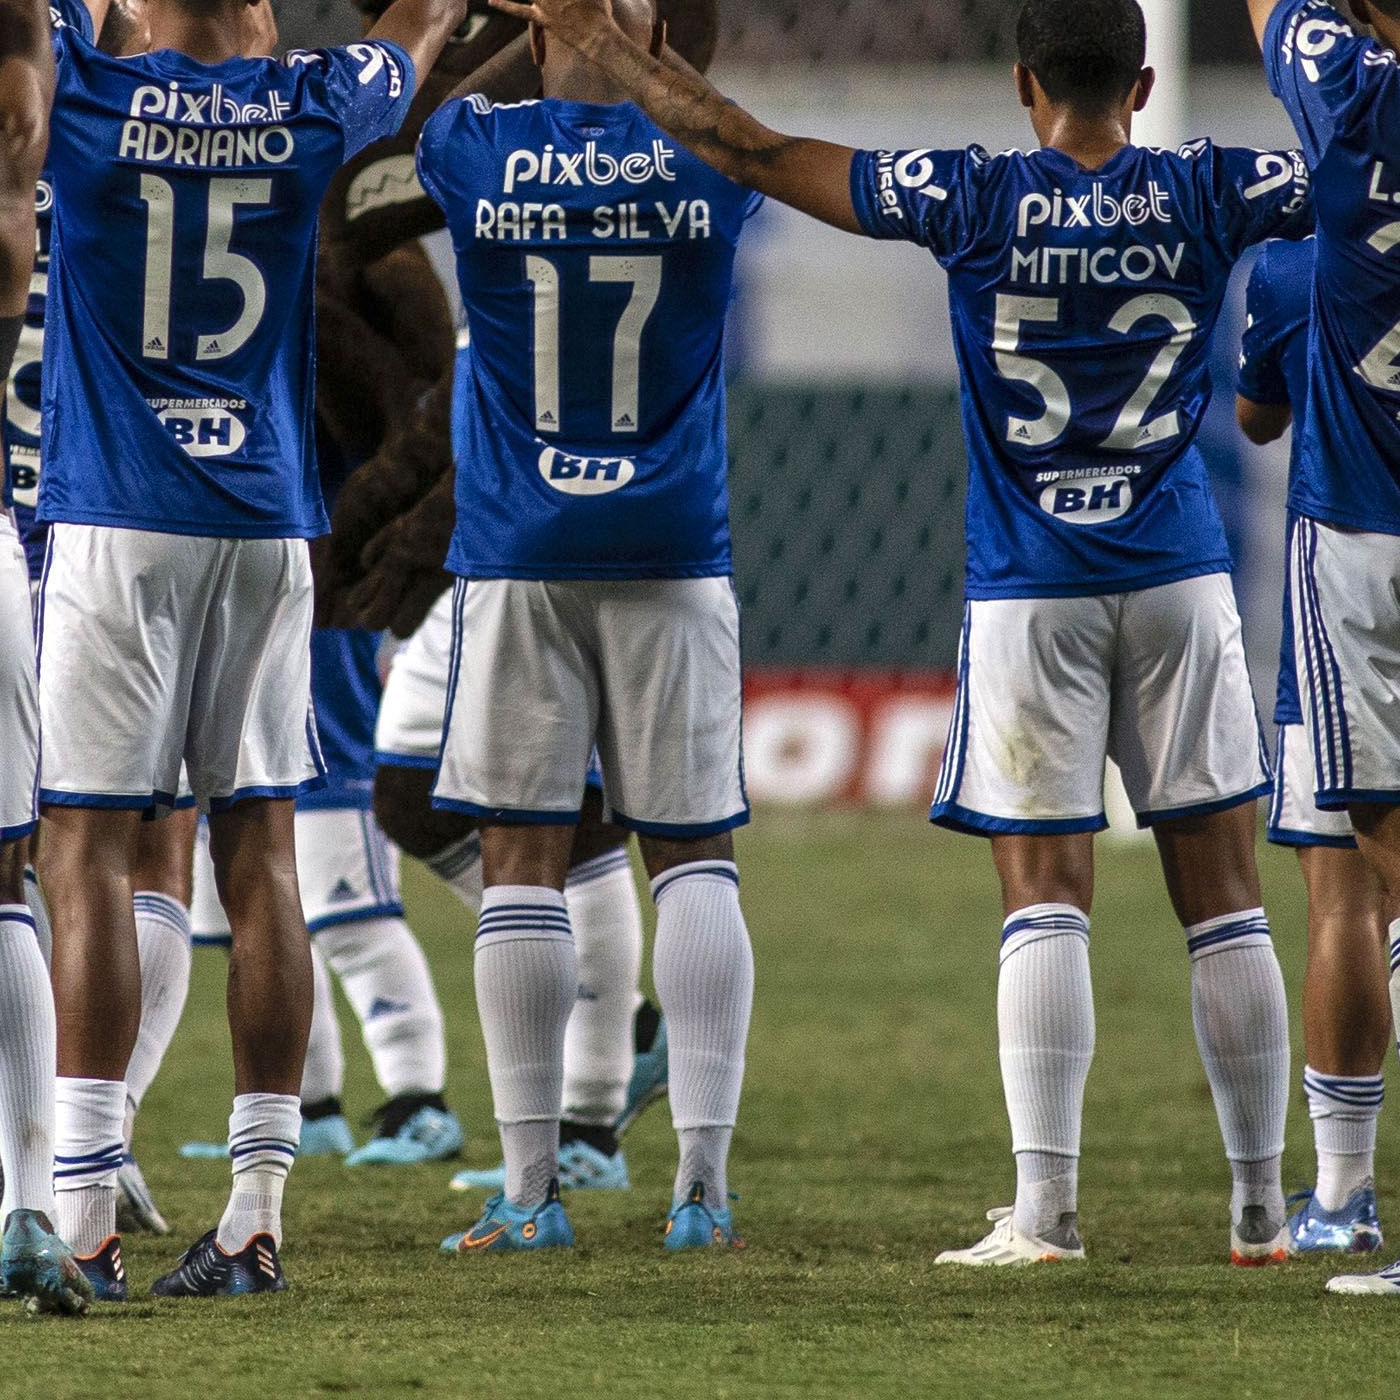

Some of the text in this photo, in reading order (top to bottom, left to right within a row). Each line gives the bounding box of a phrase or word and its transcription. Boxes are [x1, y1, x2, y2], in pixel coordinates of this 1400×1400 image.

[130, 81, 292, 125] pixbet
[118, 121, 294, 167] ADRIANO
[503, 139, 676, 193] pixbet
[475, 199, 710, 240] RAFA SILVA
[1016, 181, 1172, 238] pixbet
[140, 173, 273, 360] 15
[1010, 243, 1185, 284] MITICOV
[525, 255, 663, 433] 17
[992, 293, 1198, 450] 52
[145, 397, 247, 410] SUPERMERCADOS
[164, 417, 232, 447] BH
[549, 451, 623, 482] BH
[1035, 465, 1142, 483] SUPERMERCADOS
[1052, 479, 1127, 515] BH
